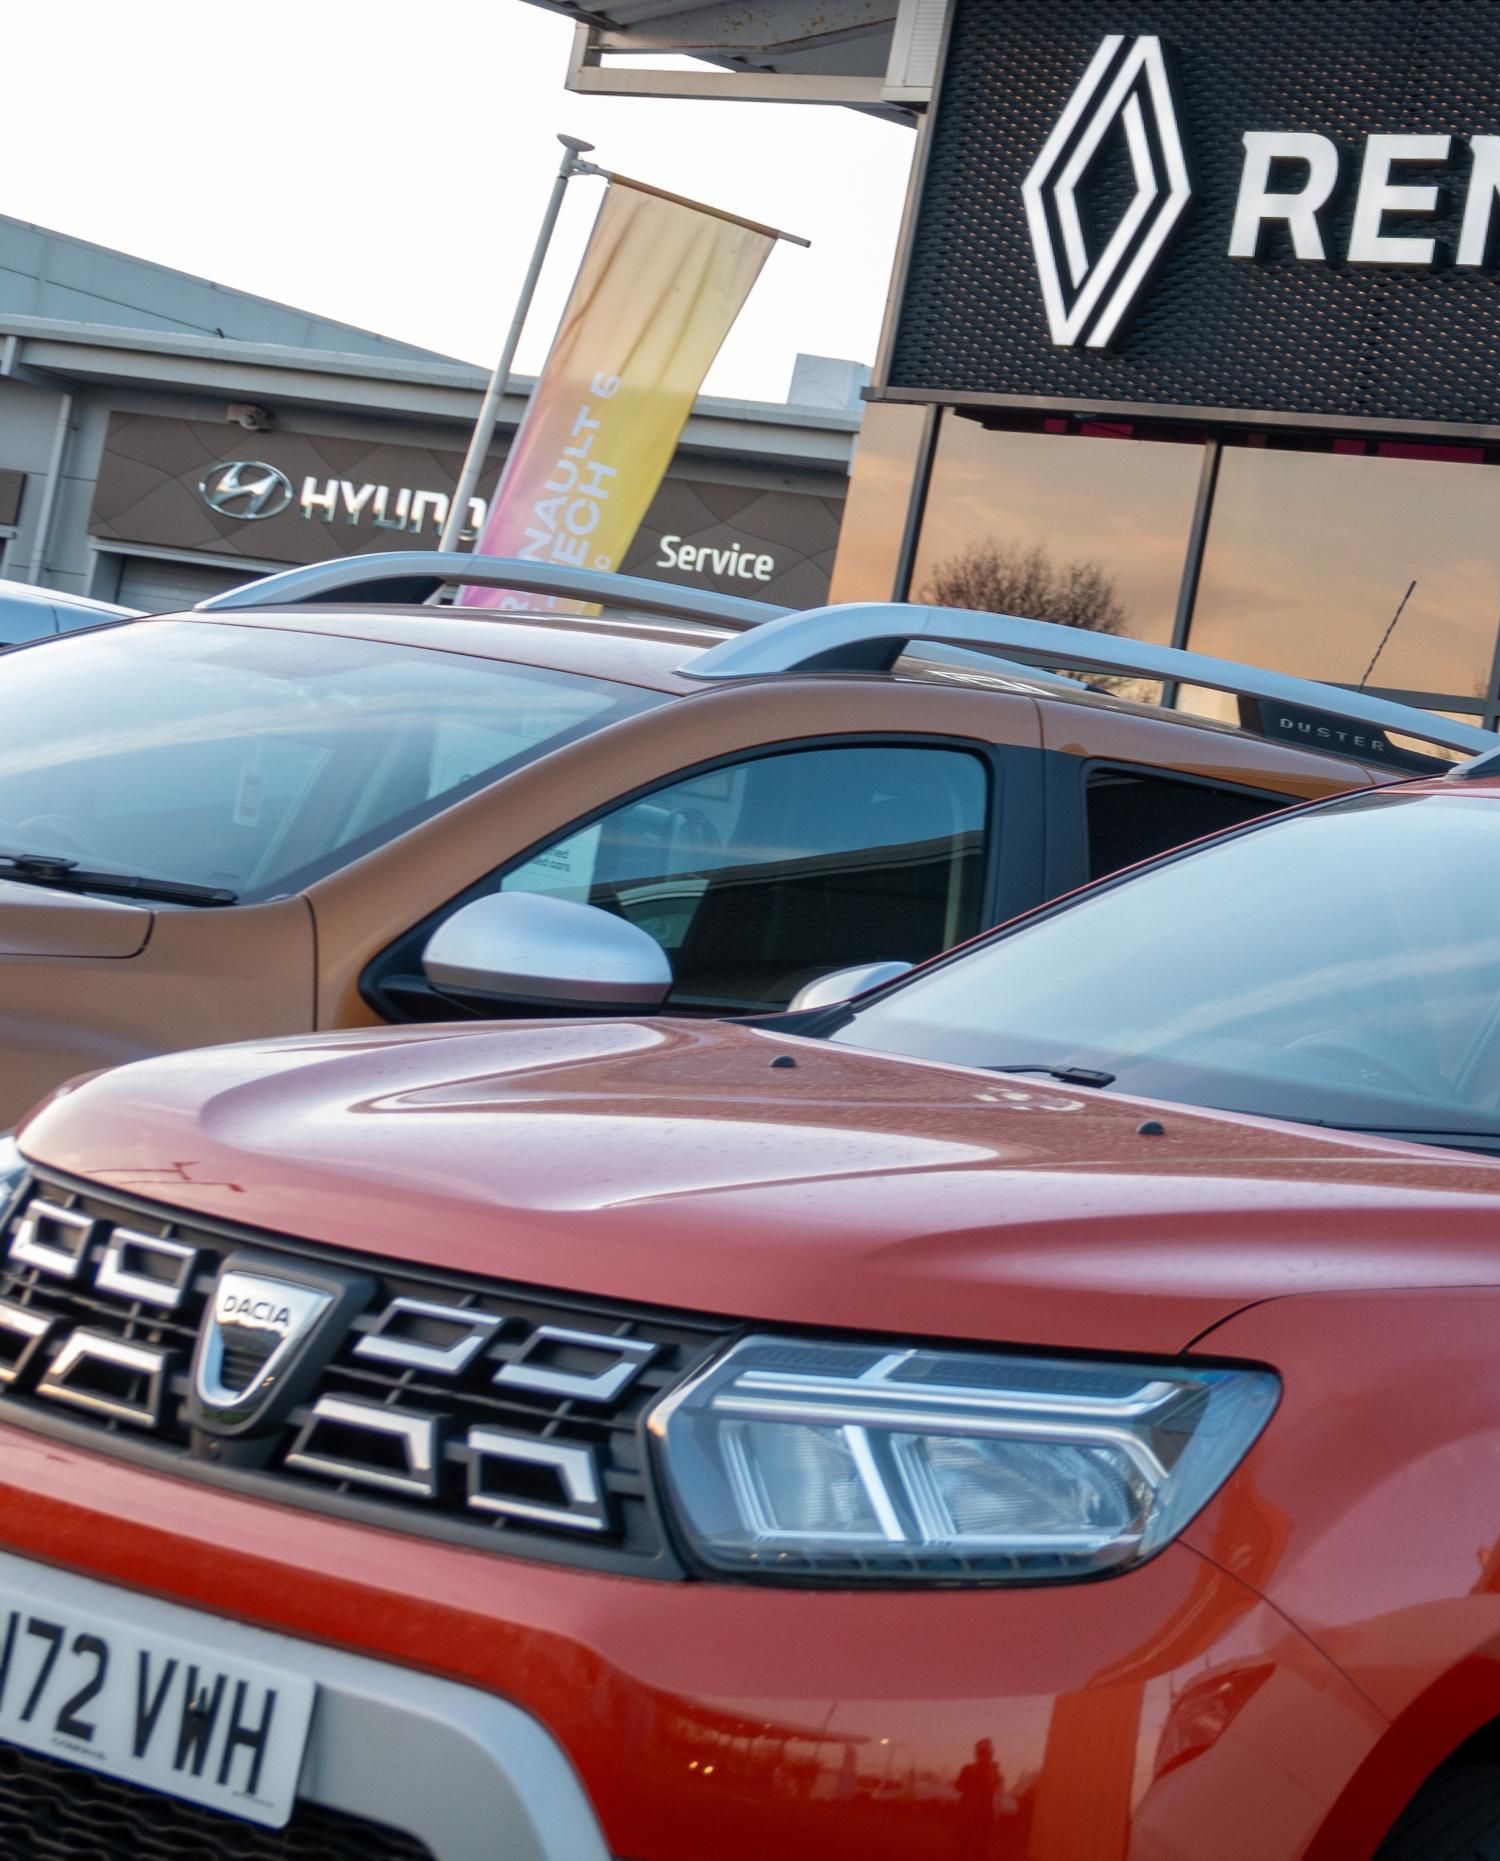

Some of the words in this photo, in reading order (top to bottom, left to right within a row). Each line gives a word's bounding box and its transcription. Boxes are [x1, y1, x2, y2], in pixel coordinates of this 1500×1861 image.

[656, 535, 775, 581] Service
[1280, 718, 1384, 751] DUSTER
[224, 1296, 290, 1327] DACIA
[132, 1650, 278, 1795] VWH
